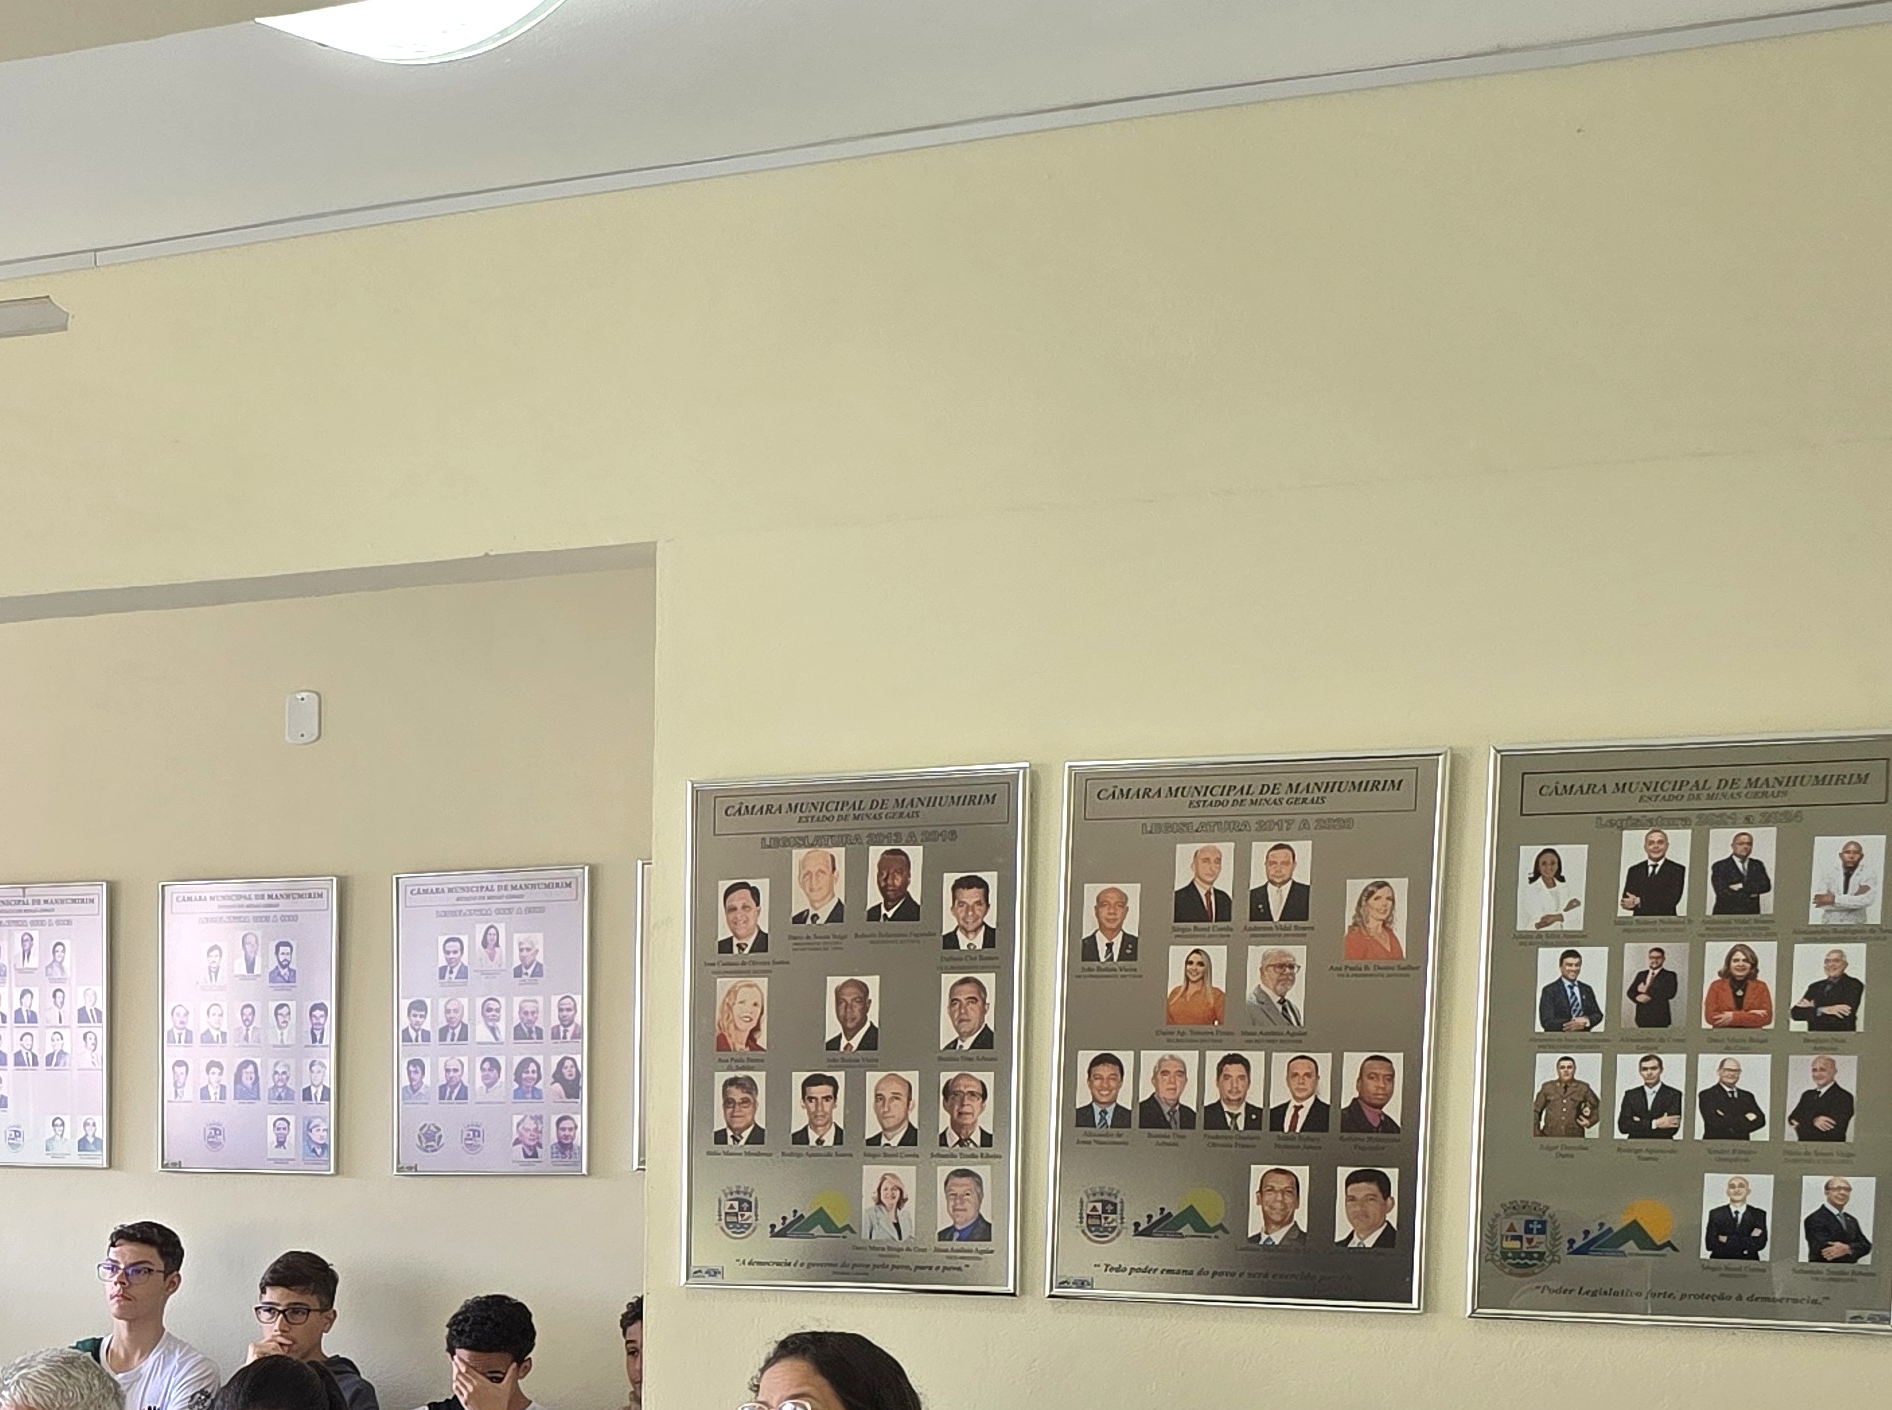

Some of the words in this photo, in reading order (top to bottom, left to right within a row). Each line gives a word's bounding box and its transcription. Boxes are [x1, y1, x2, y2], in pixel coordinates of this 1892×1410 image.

[1095, 784, 1162, 801] CÂMARA
[1164, 783, 1256, 799] MUNICIPAL
[1258, 783, 1280, 795] DE
[1284, 779, 1404, 795] MANHUMIRIM
[1537, 779, 1608, 797] CÂMARA
[1611, 777, 1713, 795] MUNICIPAL
[1716, 777, 1741, 791] DE
[1744, 772, 1872, 790] MANHUMIRIM
[723, 801, 784, 818] CÂMARA
[785, 798, 866, 815] MUNICIPAL
[868, 797, 890, 810] DE
[891, 792, 998, 810] MANHUMIRIM
[1187, 798, 1230, 809] ESTADO
[1230, 797, 1246, 808] DE
[1248, 796, 1284, 807] MINAS
[1285, 795, 1327, 806] GERAIS
[1637, 792, 1685, 804] ESTADO
[1686, 791, 1704, 802] DE
[1705, 790, 1743, 802] MINAS
[796, 814, 836, 825] ESTADO
[1102, 1262, 1127, 1275] Todo
[1128, 1264, 1158, 1278] poder
[1160, 1266, 1194, 1277] emana
[1577, 1285, 1643, 1299] Legislativo
[1678, 1290, 1733, 1304] proteção
